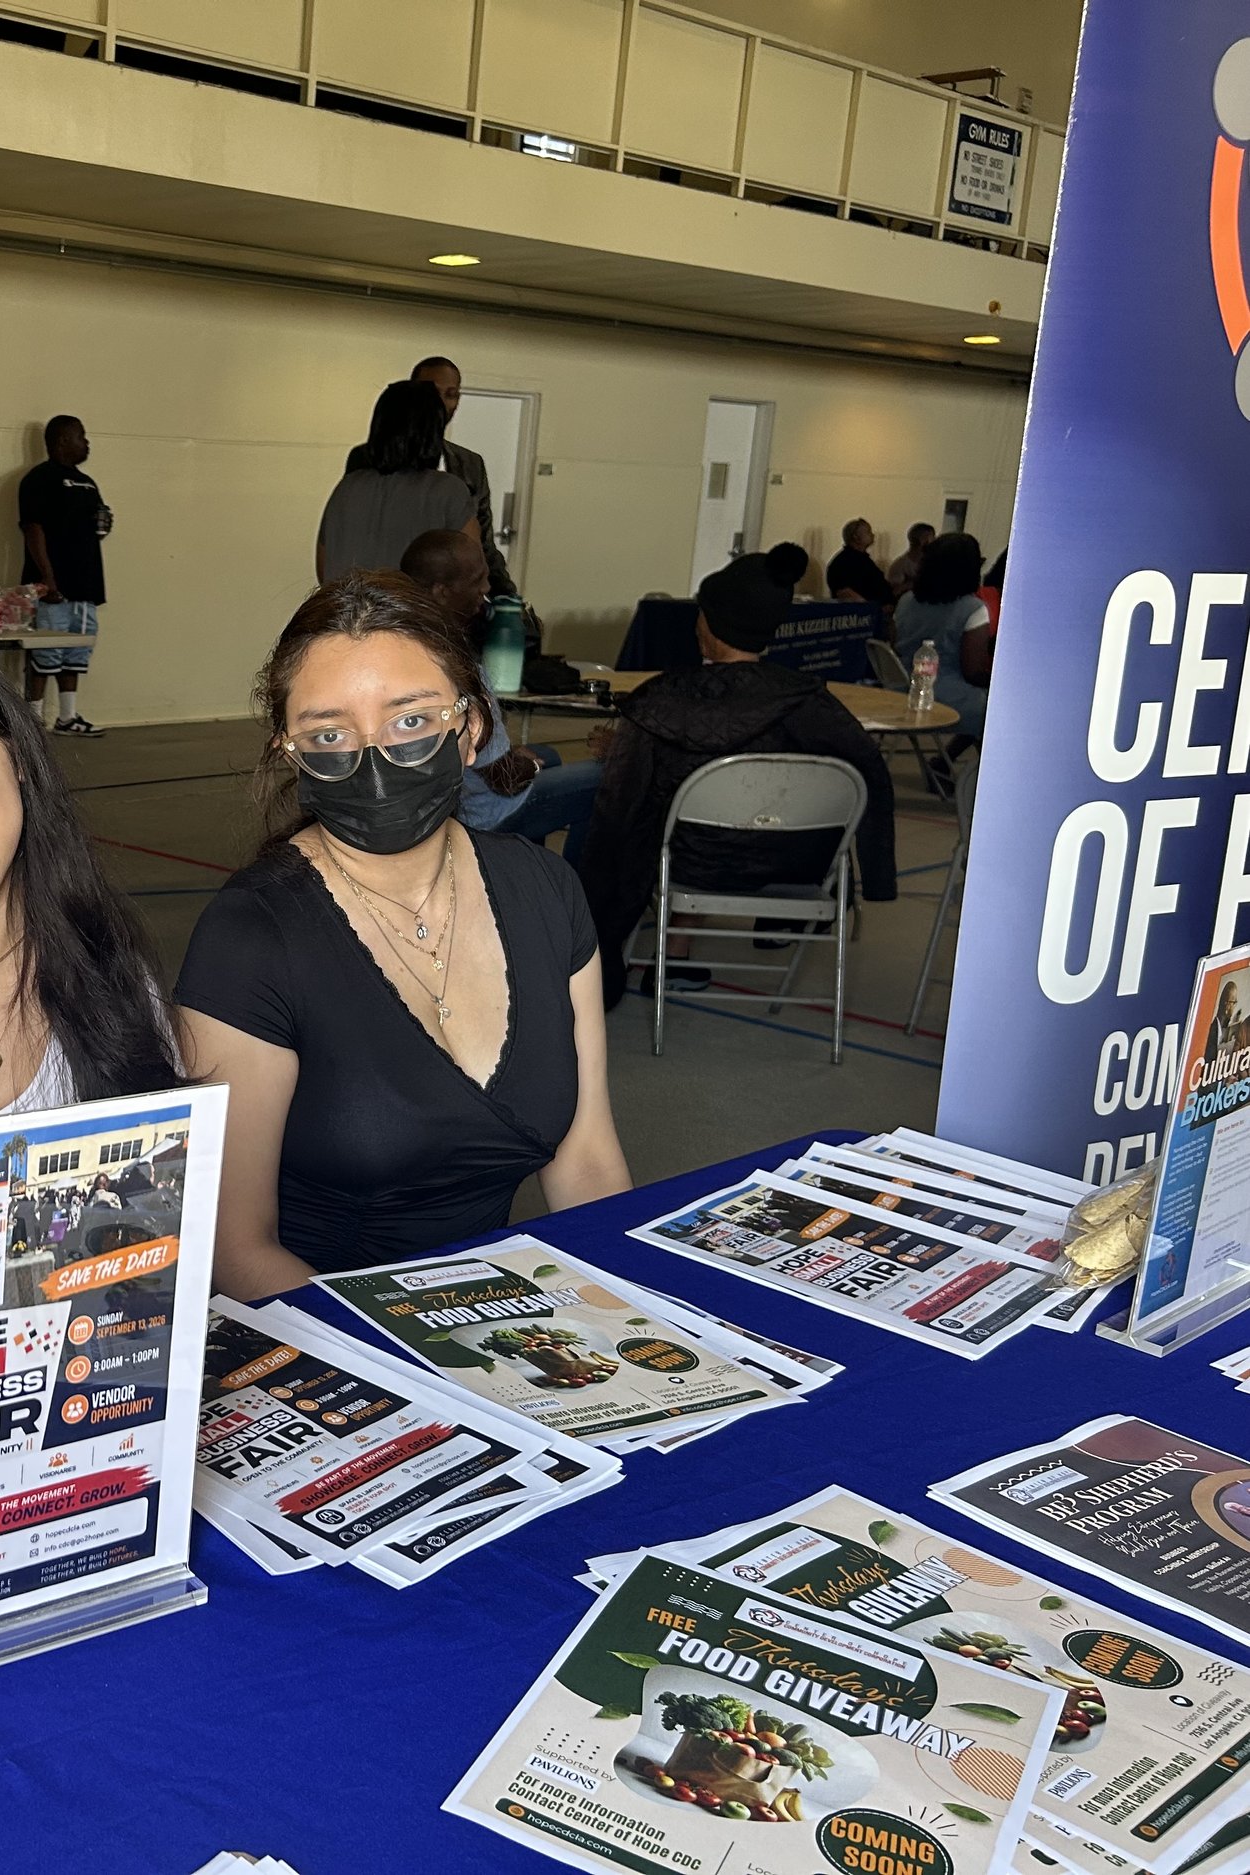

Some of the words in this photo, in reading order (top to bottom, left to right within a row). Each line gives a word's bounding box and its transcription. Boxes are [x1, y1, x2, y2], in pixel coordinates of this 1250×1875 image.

[969, 123, 987, 143] GYM
[989, 130, 1010, 148] RULES
[963, 150, 970, 161] NO
[972, 153, 987, 166] STREET
[961, 174, 967, 186] NO
[969, 176, 980, 188] FOOD
[981, 180, 988, 190] OR
[832, 614, 858, 631] FIRM
[1038, 797, 1200, 1004] OF
[1181, 1077, 1250, 1127] Brokers
[1083, 1132, 1156, 1187] DE
[57, 1266, 93, 1291] SAVE
[95, 1258, 123, 1281] THE
[126, 1245, 168, 1269] DATE!
[771, 1248, 825, 1273] HOPE
[794, 1256, 842, 1280] SMALL
[812, 1254, 874, 1287] BUSINESS
[831, 1261, 907, 1298] FAIR
[385, 1302, 420, 1317] FREE
[414, 1306, 482, 1329] FOOD
[478, 1287, 589, 1318] GIVEAWAY
[423, 1286, 527, 1308] Thursdays
[96, 1320, 136, 1339] SEPTEMBER
[138, 1319, 147, 1331] 13,
[148, 1315, 166, 1328] 2026
[97, 1312, 124, 1326] SUNDAY
[94, 1356, 123, 1372] 9:00AM
[132, 1348, 160, 1363] 1:00PM
[228, 1370, 251, 1385] SAVE
[249, 1363, 268, 1377] THE
[264, 1349, 292, 1369] DATE!
[621, 1341, 674, 1361] COMING
[649, 1352, 690, 1369] SOON!
[90, 1397, 154, 1424] OPPORTUNITY
[92, 1384, 136, 1408] VENDOR
[197, 1411, 292, 1461] BUSINESS
[206, 1421, 324, 1479] FAIR
[108, 1449, 144, 1462] COMMUNITY
[300, 1473, 363, 1507] SHOWCASE.
[360, 1447, 410, 1475] CONNECT.
[407, 1431, 441, 1452] GROW.
[1074, 1449, 1198, 1506] SHEPHERD'S
[1, 1499, 19, 1511] THE
[22, 1484, 76, 1506] MOVEMENT.
[1, 1495, 75, 1525] CONNECT.
[80, 1482, 126, 1504] GROW.
[1064, 1487, 1174, 1535] PROGRAM
[40, 1570, 75, 1583] TOGETHER,
[77, 1565, 86, 1573] WE
[89, 1559, 108, 1570] BUILD
[41, 1562, 75, 1575] TOGETHER,
[89, 1551, 108, 1562] BUILD
[783, 1562, 890, 1606] Thursdays
[849, 1556, 971, 1625] GIVEAWAY
[646, 1607, 698, 1634] FREE
[723, 1627, 905, 1706] Thursdays
[1080, 1634, 1130, 1674] COMING
[1122, 1650, 1166, 1682] SOON!
[658, 1630, 761, 1683] FOOD
[764, 1669, 976, 1762] GIVEAWAY
[530, 1756, 596, 1790] PAVILIONS
[534, 1744, 599, 1776] Supported
[600, 1770, 617, 1782] by
[1048, 1768, 1092, 1799] PAVILIONS
[515, 1770, 538, 1788] For
[539, 1782, 577, 1803] more
[578, 1796, 666, 1841] Information
[508, 1782, 562, 1812] Contact
[564, 1806, 614, 1832] Center
[614, 1826, 632, 1842] of
[630, 1834, 670, 1858] Hope
[671, 1851, 702, 1871] CDC
[527, 1814, 613, 1856] hopecdcla.com
[830, 1817, 935, 1864] COMING
